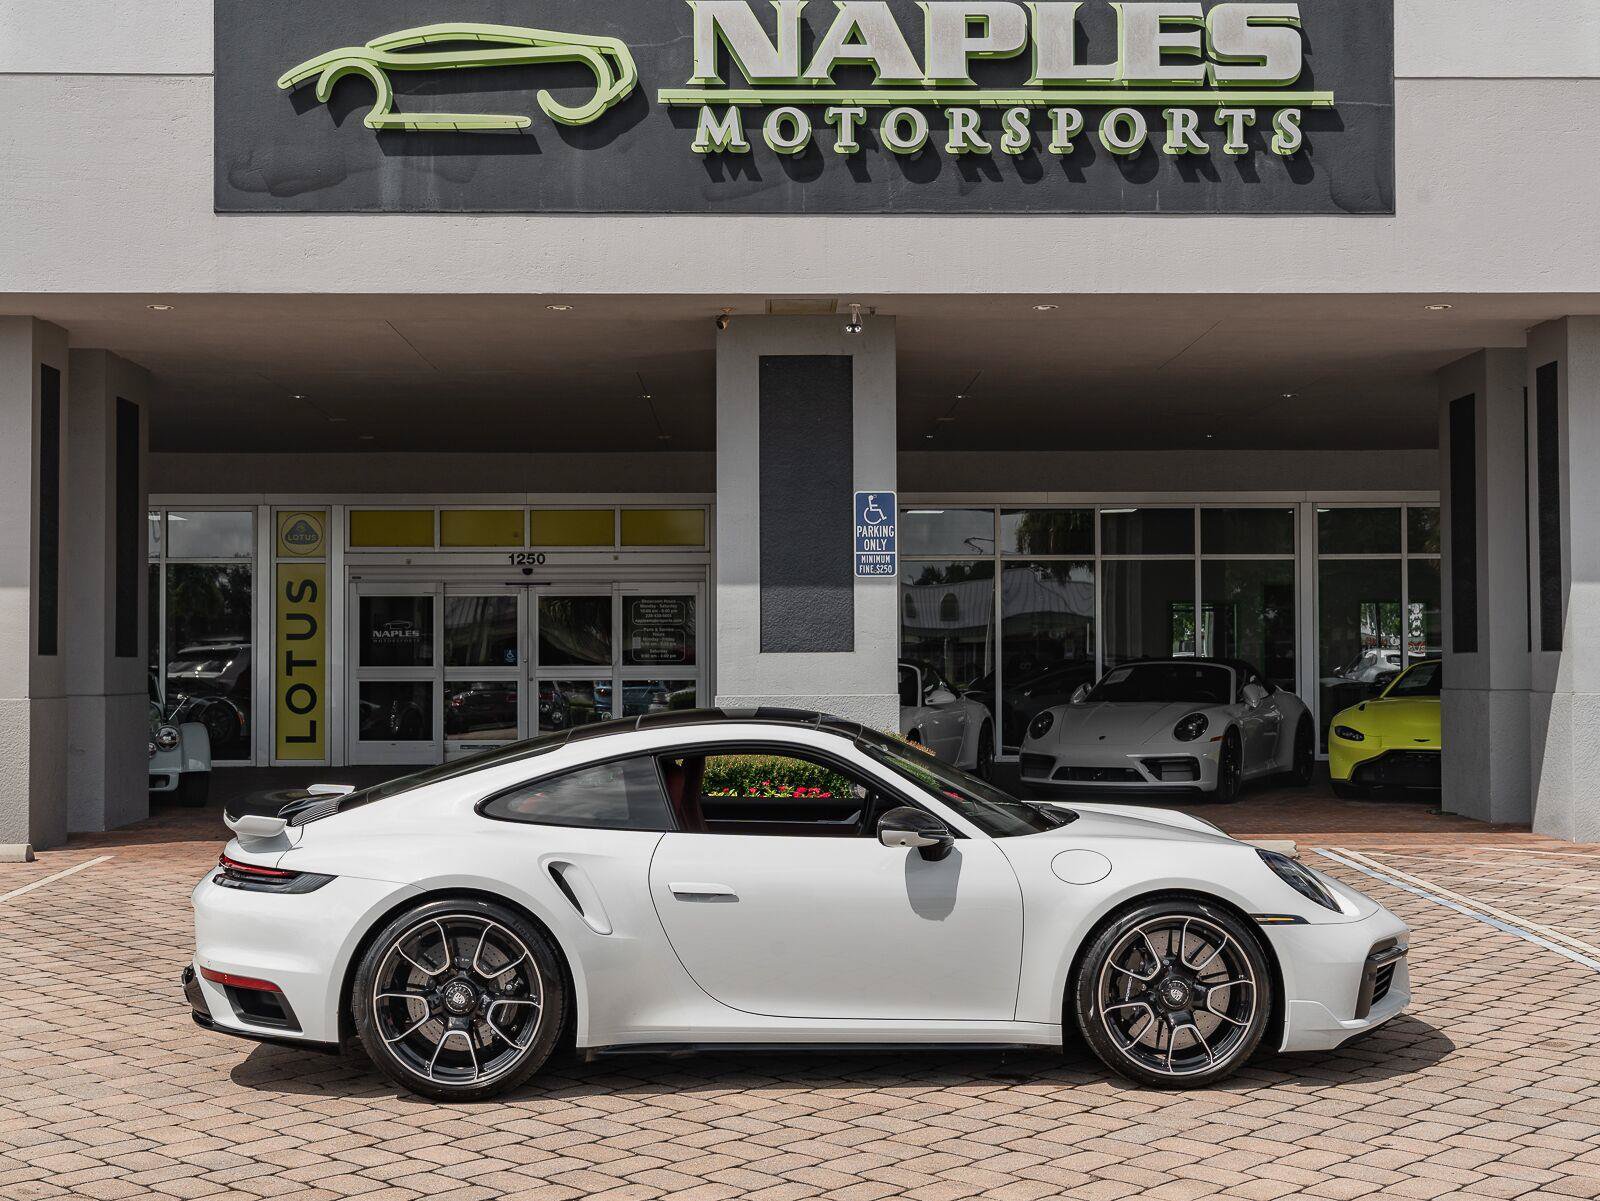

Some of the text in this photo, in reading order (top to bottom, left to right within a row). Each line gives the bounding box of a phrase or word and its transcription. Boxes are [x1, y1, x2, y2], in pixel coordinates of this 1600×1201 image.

[686, 0, 1302, 86] NAPLES
[692, 106, 1303, 154] MOTORSPORTS
[856, 525, 895, 538] PARKING
[863, 539, 888, 551] ONLY
[508, 553, 546, 566] 1250
[861, 554, 891, 564] MINIMUM
[859, 564, 893, 574] FINE $250
[285, 579, 318, 743] LOTUS
